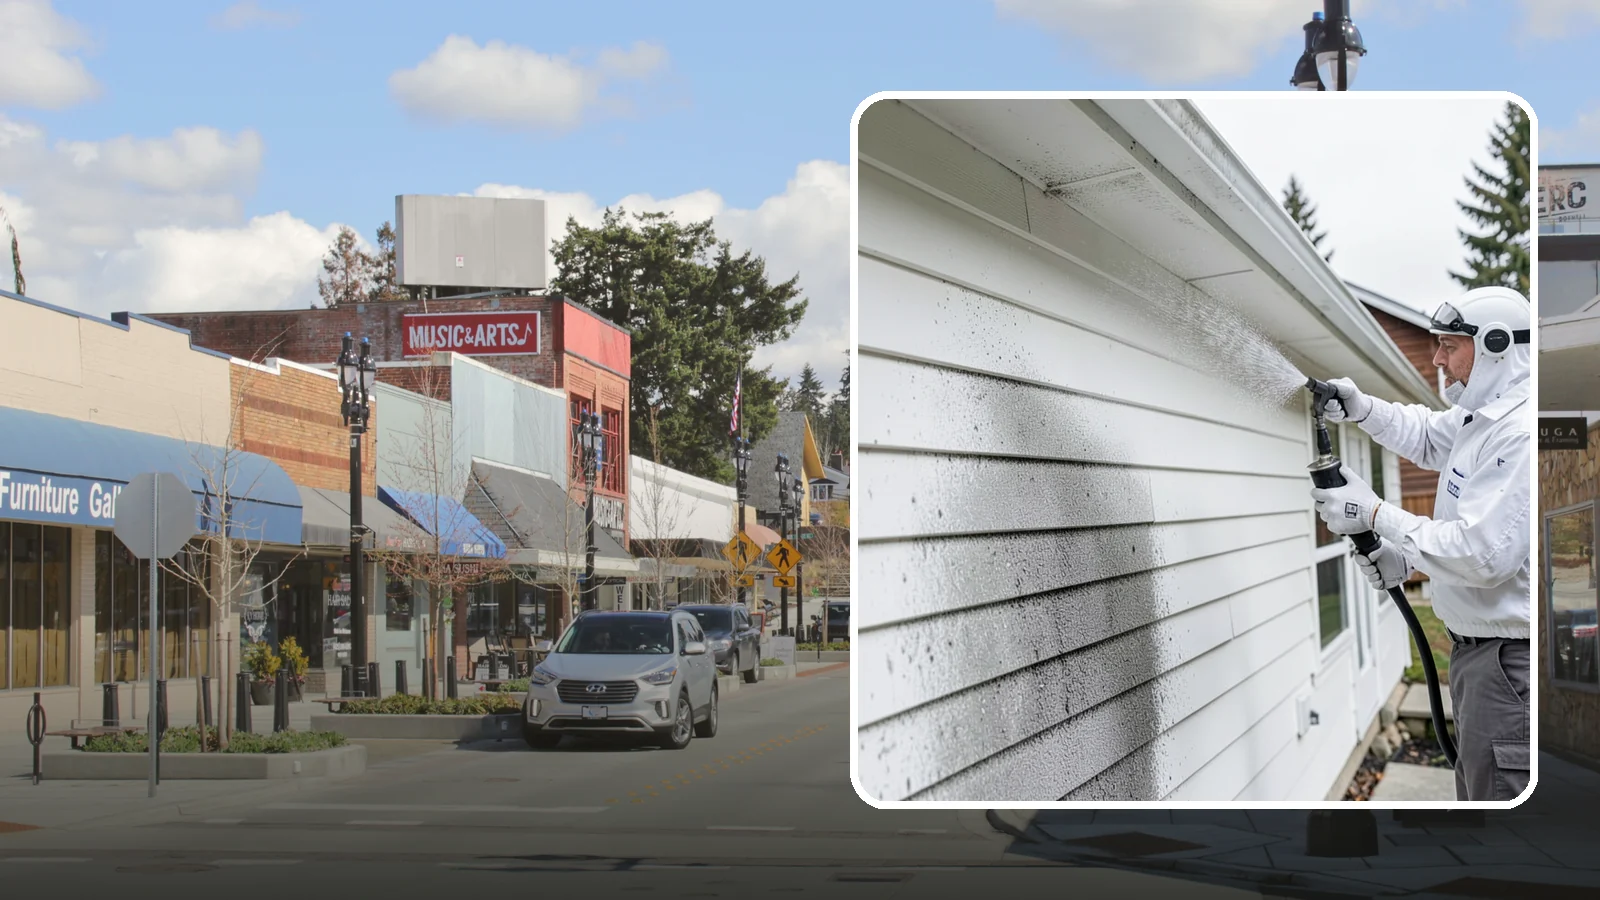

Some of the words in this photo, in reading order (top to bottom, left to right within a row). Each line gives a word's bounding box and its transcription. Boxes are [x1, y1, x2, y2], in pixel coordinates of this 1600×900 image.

[0, 471, 79, 515] Furniture
[89, 482, 122, 518] Gal
[452, 563, 479, 574] SUSHI
